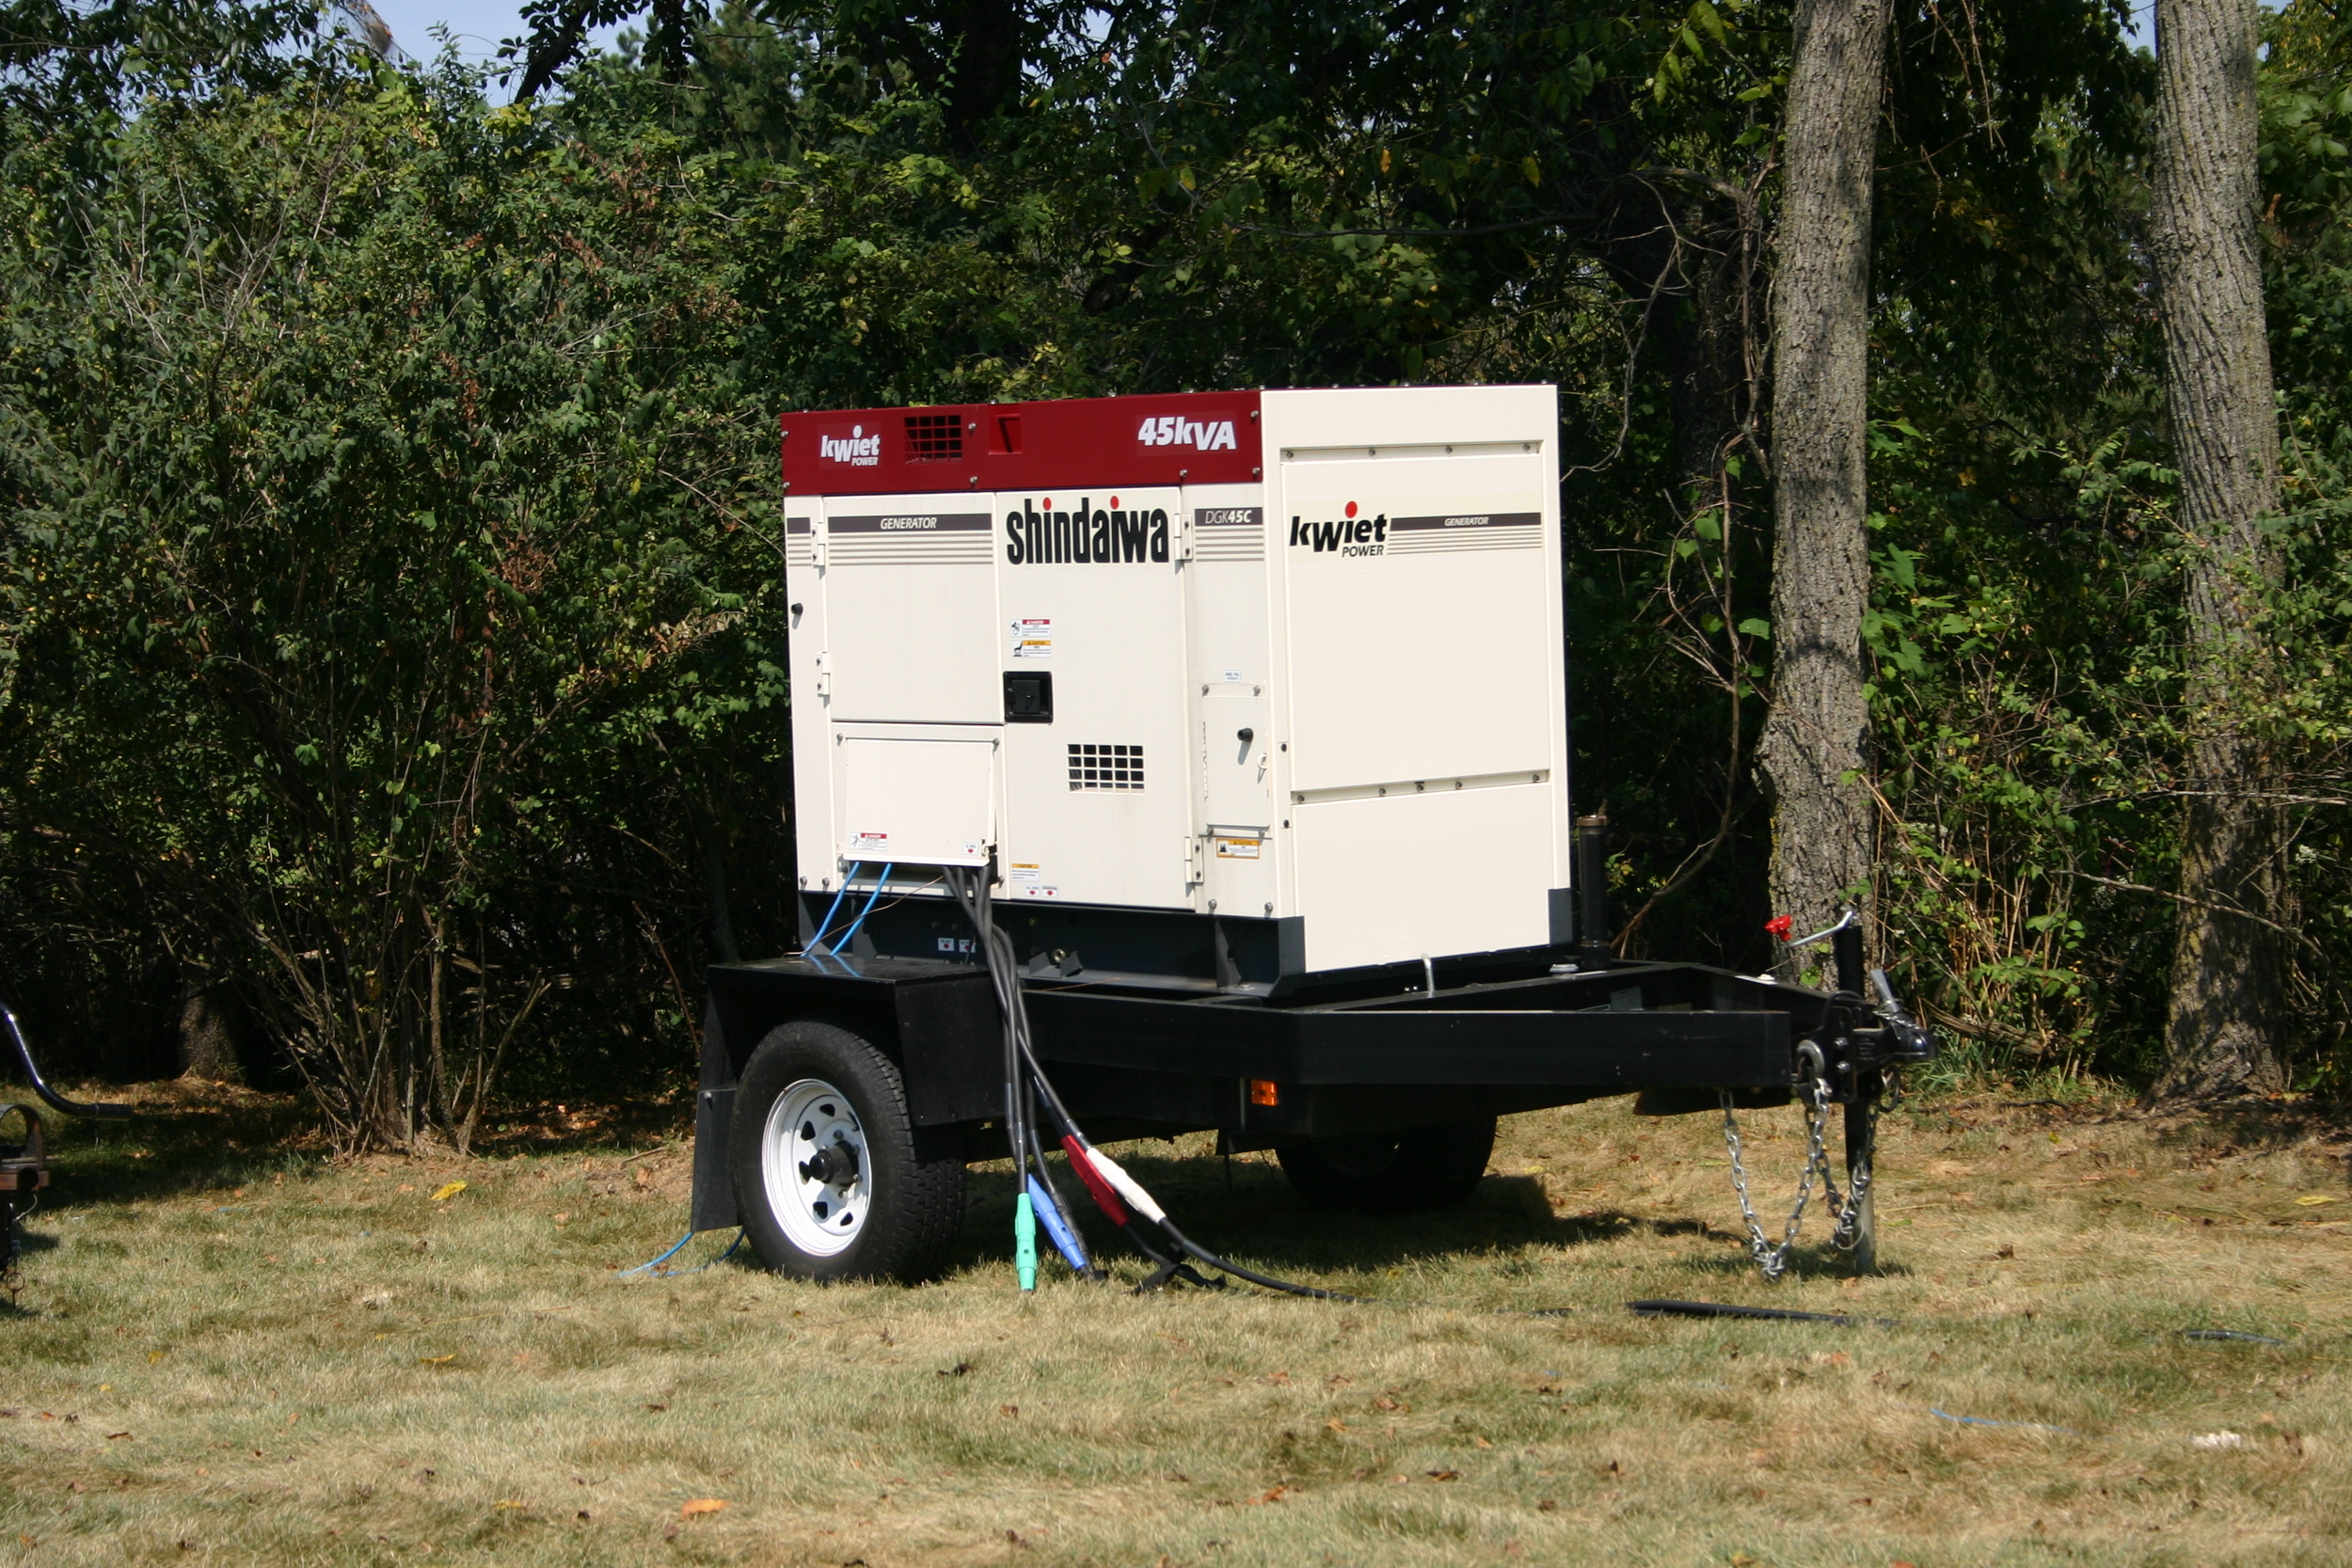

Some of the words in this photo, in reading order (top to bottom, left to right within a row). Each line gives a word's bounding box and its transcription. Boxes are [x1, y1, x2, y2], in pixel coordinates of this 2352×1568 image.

[1137, 416, 1237, 451] 45kVA
[820, 425, 881, 463] kwiet
[851, 457, 879, 467] POWER
[880, 516, 937, 530] GENERATOR
[1205, 510, 1252, 524] DGK45C
[1445, 517, 1489, 527] GENERATOR
[1007, 496, 1169, 565] shindaiwa
[1290, 500, 1388, 552] kwiet
[1342, 545, 1384, 558] POWER
